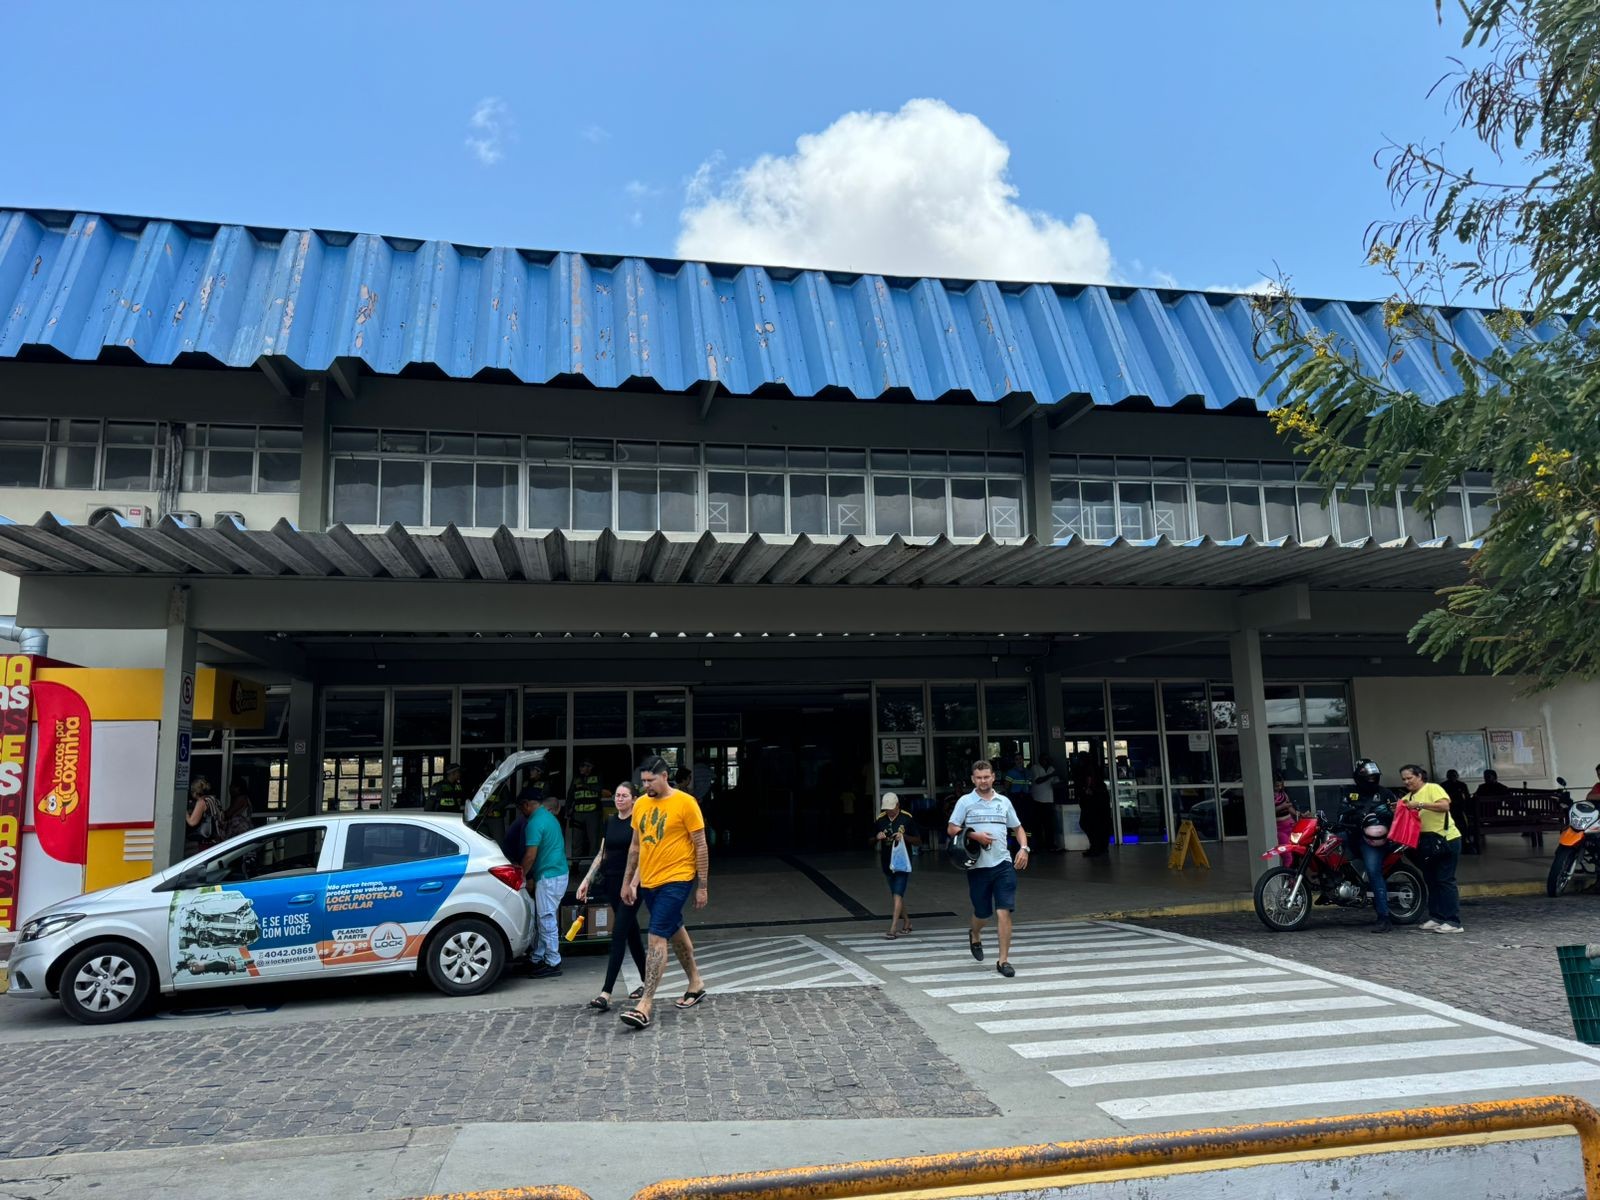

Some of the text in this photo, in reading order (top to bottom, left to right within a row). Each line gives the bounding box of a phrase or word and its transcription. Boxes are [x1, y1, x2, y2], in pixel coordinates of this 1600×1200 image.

[52, 720, 65, 783] Loucos por
[58, 716, 80, 798] Coxinha
[341, 882, 360, 890] perca
[326, 889, 351, 897] proteja
[326, 889, 403, 904] LOCK PROTEÇÃO
[327, 901, 374, 912] VEICULAR
[262, 913, 310, 928] E SE FOSSE
[263, 923, 311, 939] COM VOCÊ?
[337, 928, 364, 936] PLANOS
[344, 933, 368, 941] PARTIR
[374, 940, 403, 949] LOCK
[265, 946, 314, 959] 4042.0869
